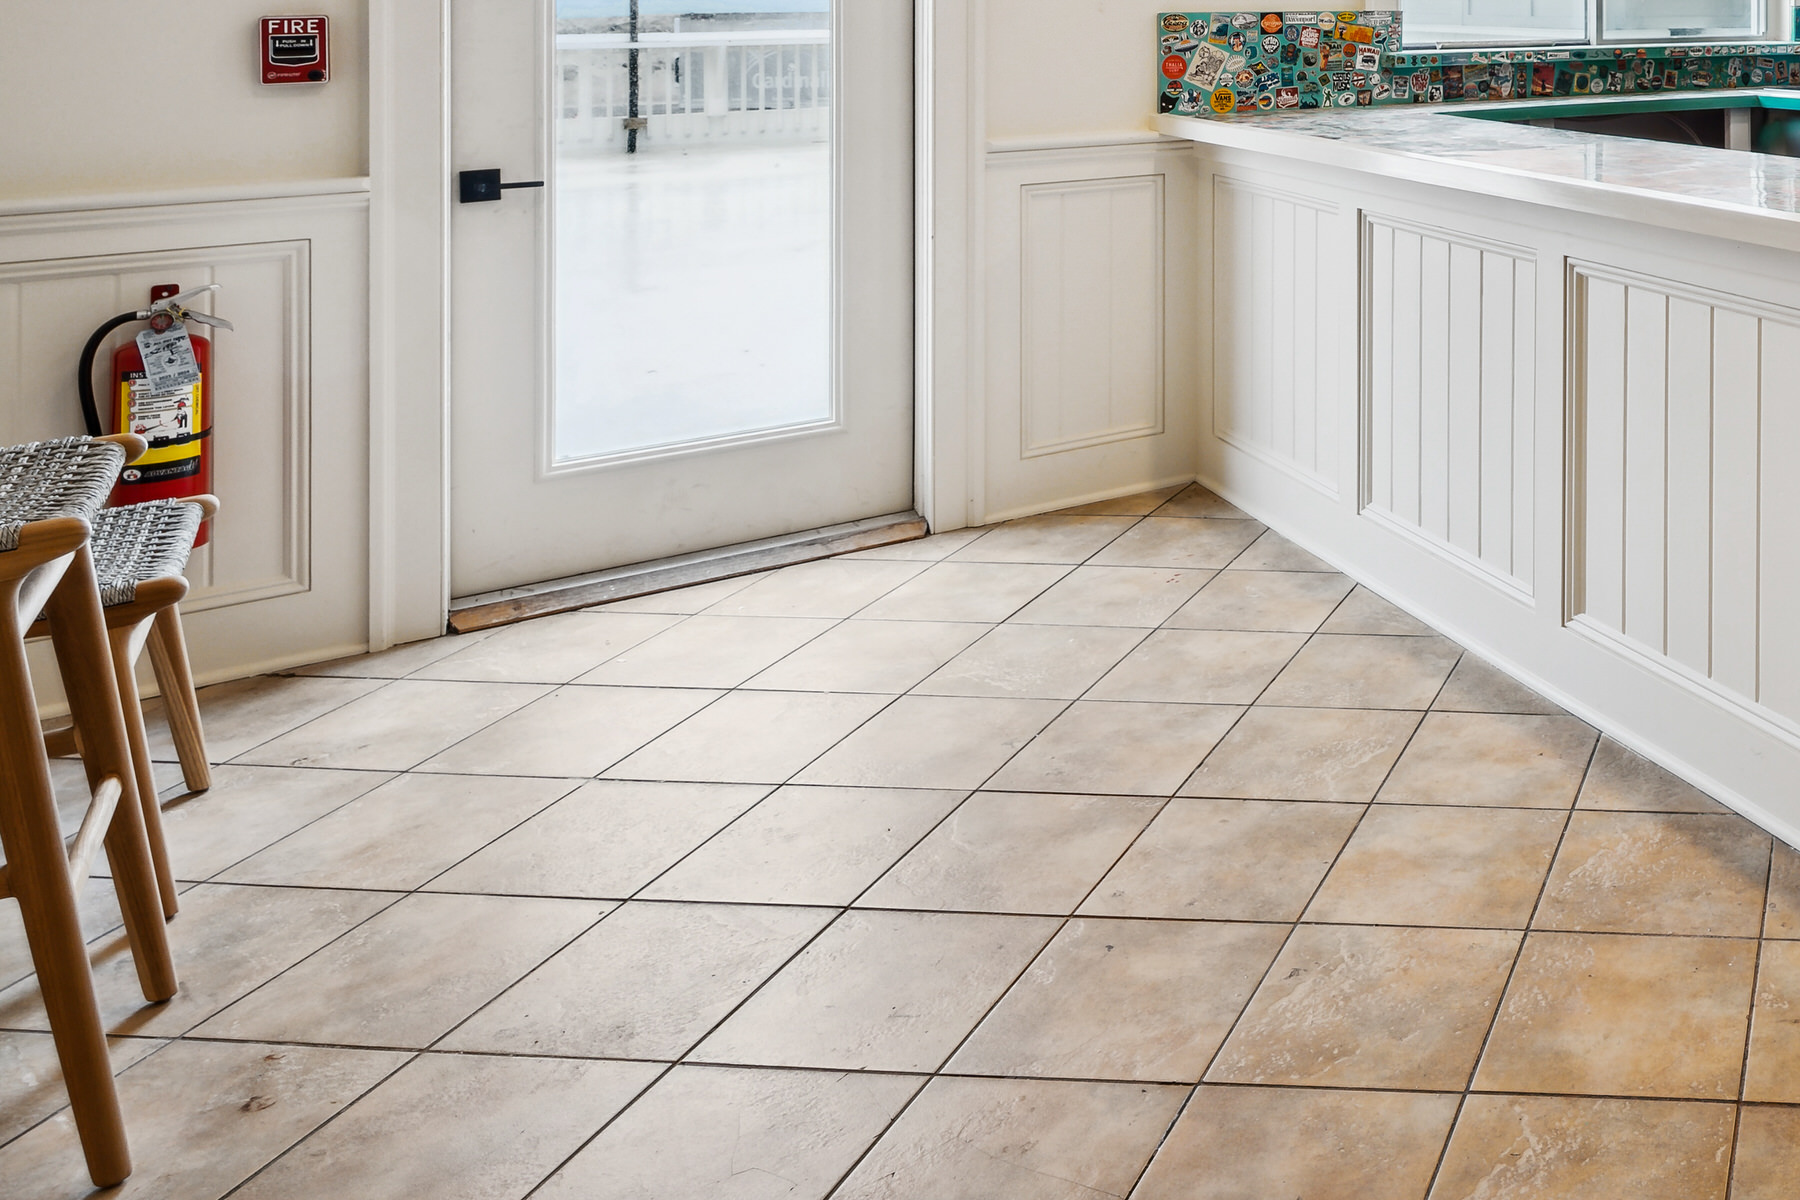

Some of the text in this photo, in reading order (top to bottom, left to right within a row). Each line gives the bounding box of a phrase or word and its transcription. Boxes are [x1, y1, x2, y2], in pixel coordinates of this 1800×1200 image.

[268, 19, 319, 33] FIRE
[1358, 47, 1380, 56] HAWAII
[1214, 93, 1232, 101] VANS
